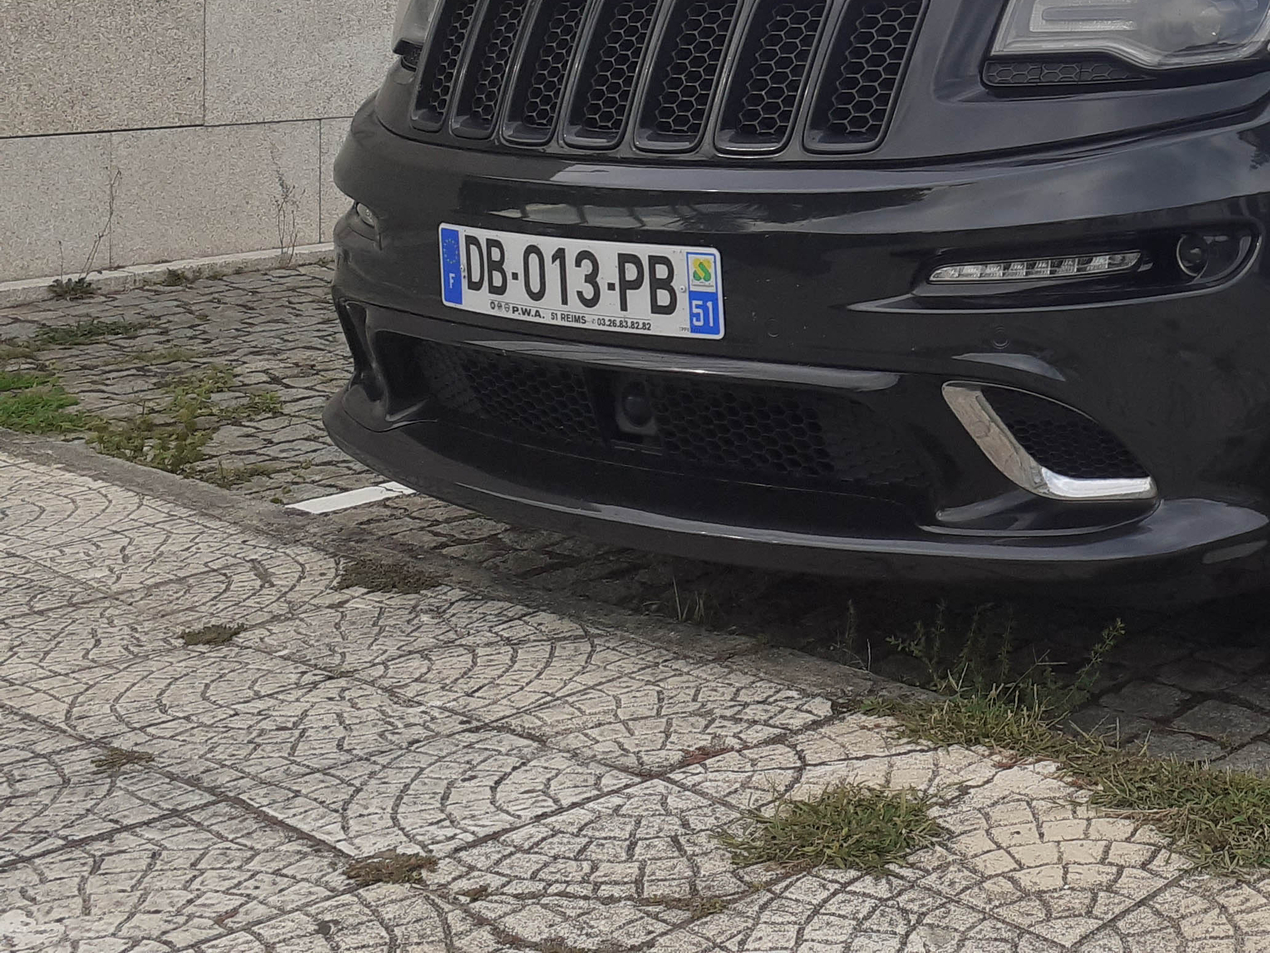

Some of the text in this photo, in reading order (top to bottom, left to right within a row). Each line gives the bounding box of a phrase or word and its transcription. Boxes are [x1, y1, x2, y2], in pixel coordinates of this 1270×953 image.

[448, 273, 456, 289] F
[464, 234, 677, 316] DB-013-PB
[511, 306, 652, 332] P.W.A. 51 REIMS 03.26.83.82.82
[691, 300, 714, 327] 51
